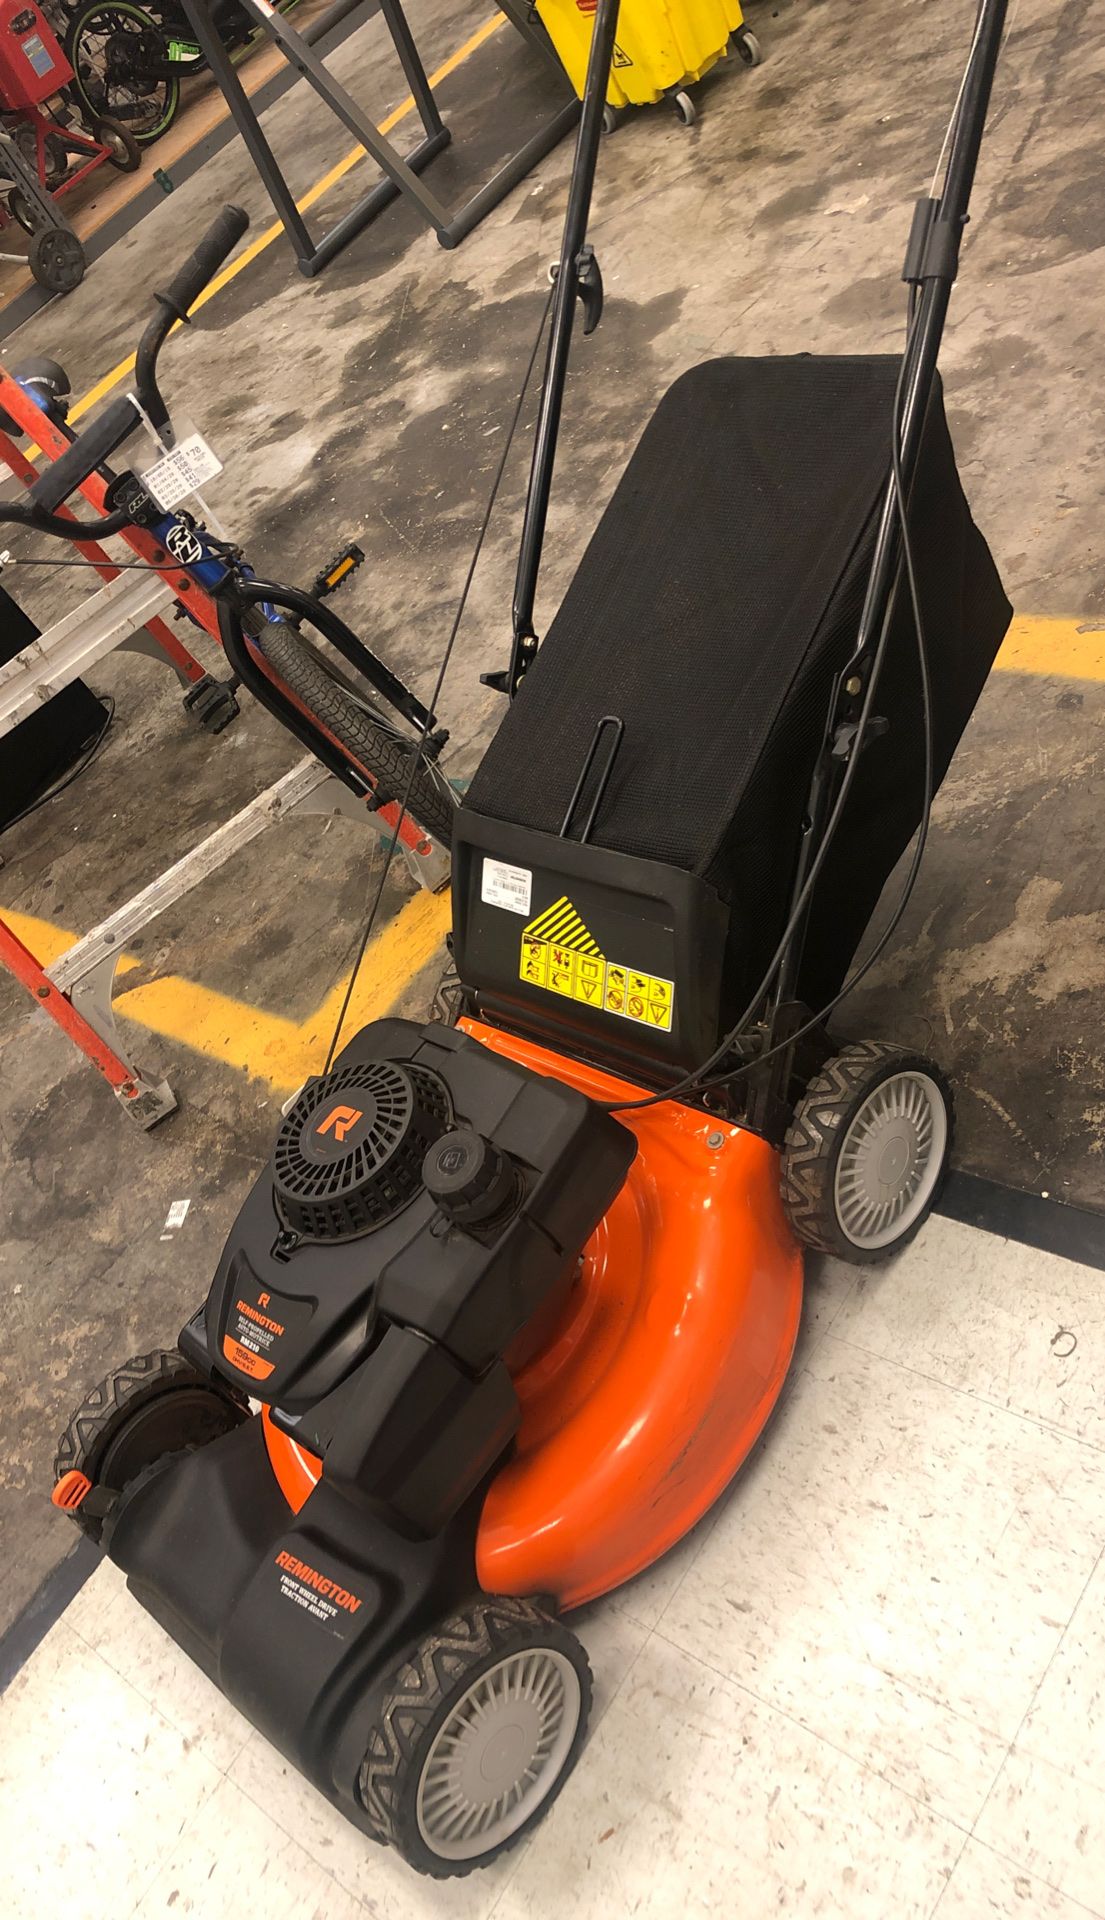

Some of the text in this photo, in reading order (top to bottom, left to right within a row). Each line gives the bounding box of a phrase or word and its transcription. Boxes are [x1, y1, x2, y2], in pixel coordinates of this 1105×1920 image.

[316, 1104, 364, 1142] R
[236, 1300, 285, 1336] REMINGTON
[257, 1292, 271, 1309] R
[275, 1550, 362, 1614] REMINGTON
[280, 1574, 338, 1617] FRONT WHEEL DRIVE
[280, 1585, 329, 1621] TRACTION AVANT
